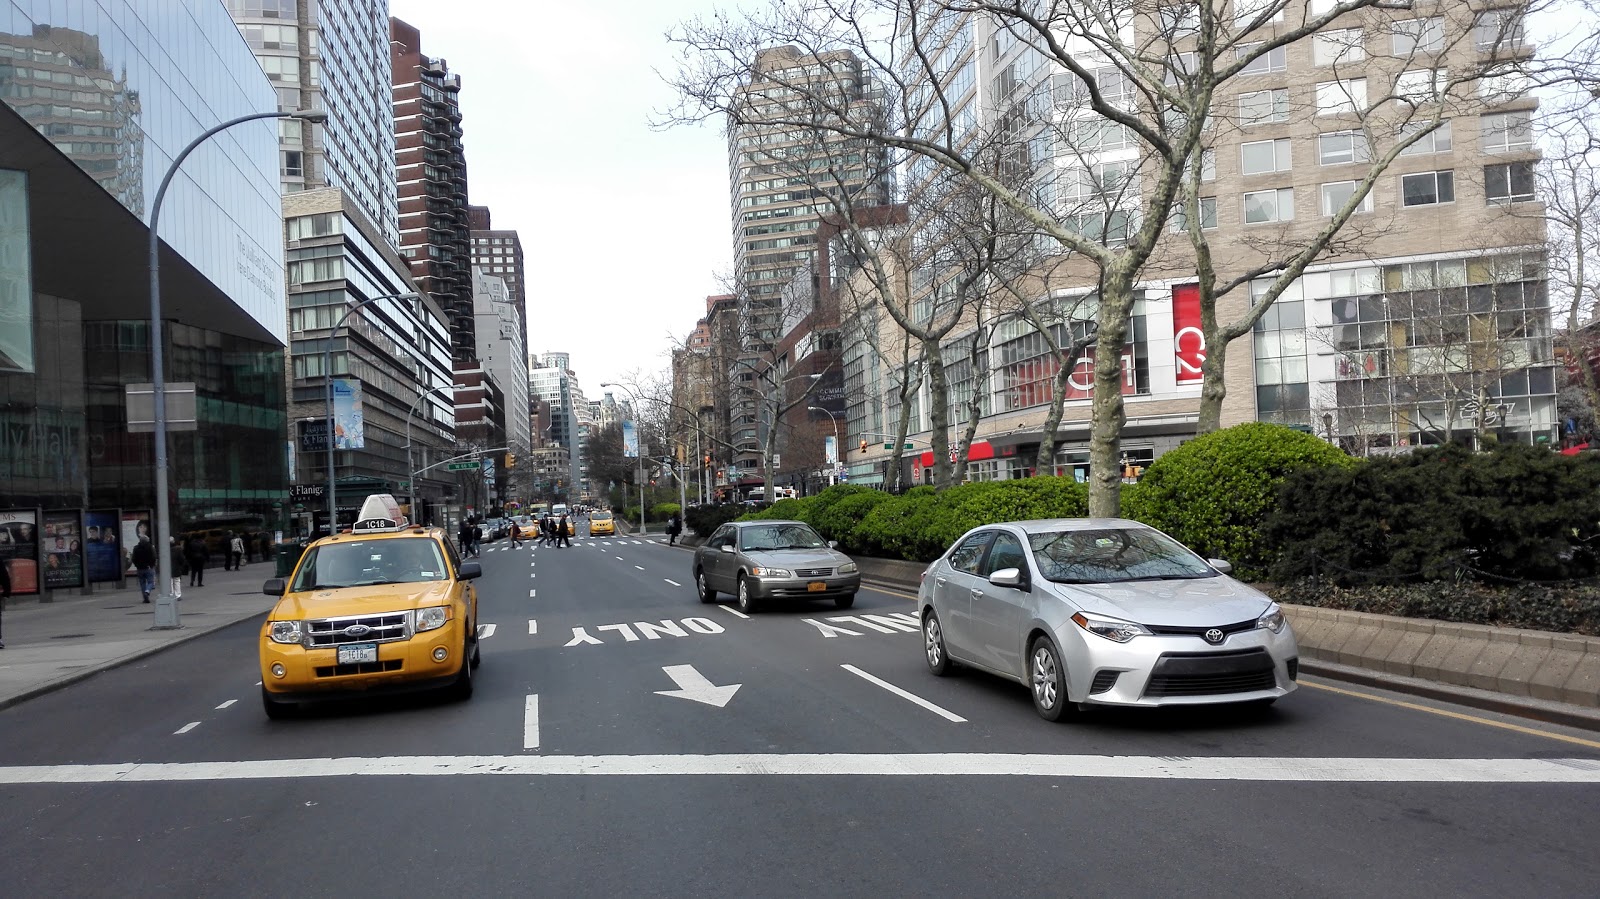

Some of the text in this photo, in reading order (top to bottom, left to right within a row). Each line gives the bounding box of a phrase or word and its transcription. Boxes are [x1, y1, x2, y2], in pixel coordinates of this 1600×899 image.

[1068, 354, 1133, 391] C1
[366, 520, 385, 529] 1C18
[563, 617, 726, 648] ONLY
[800, 610, 921, 638] NLY
